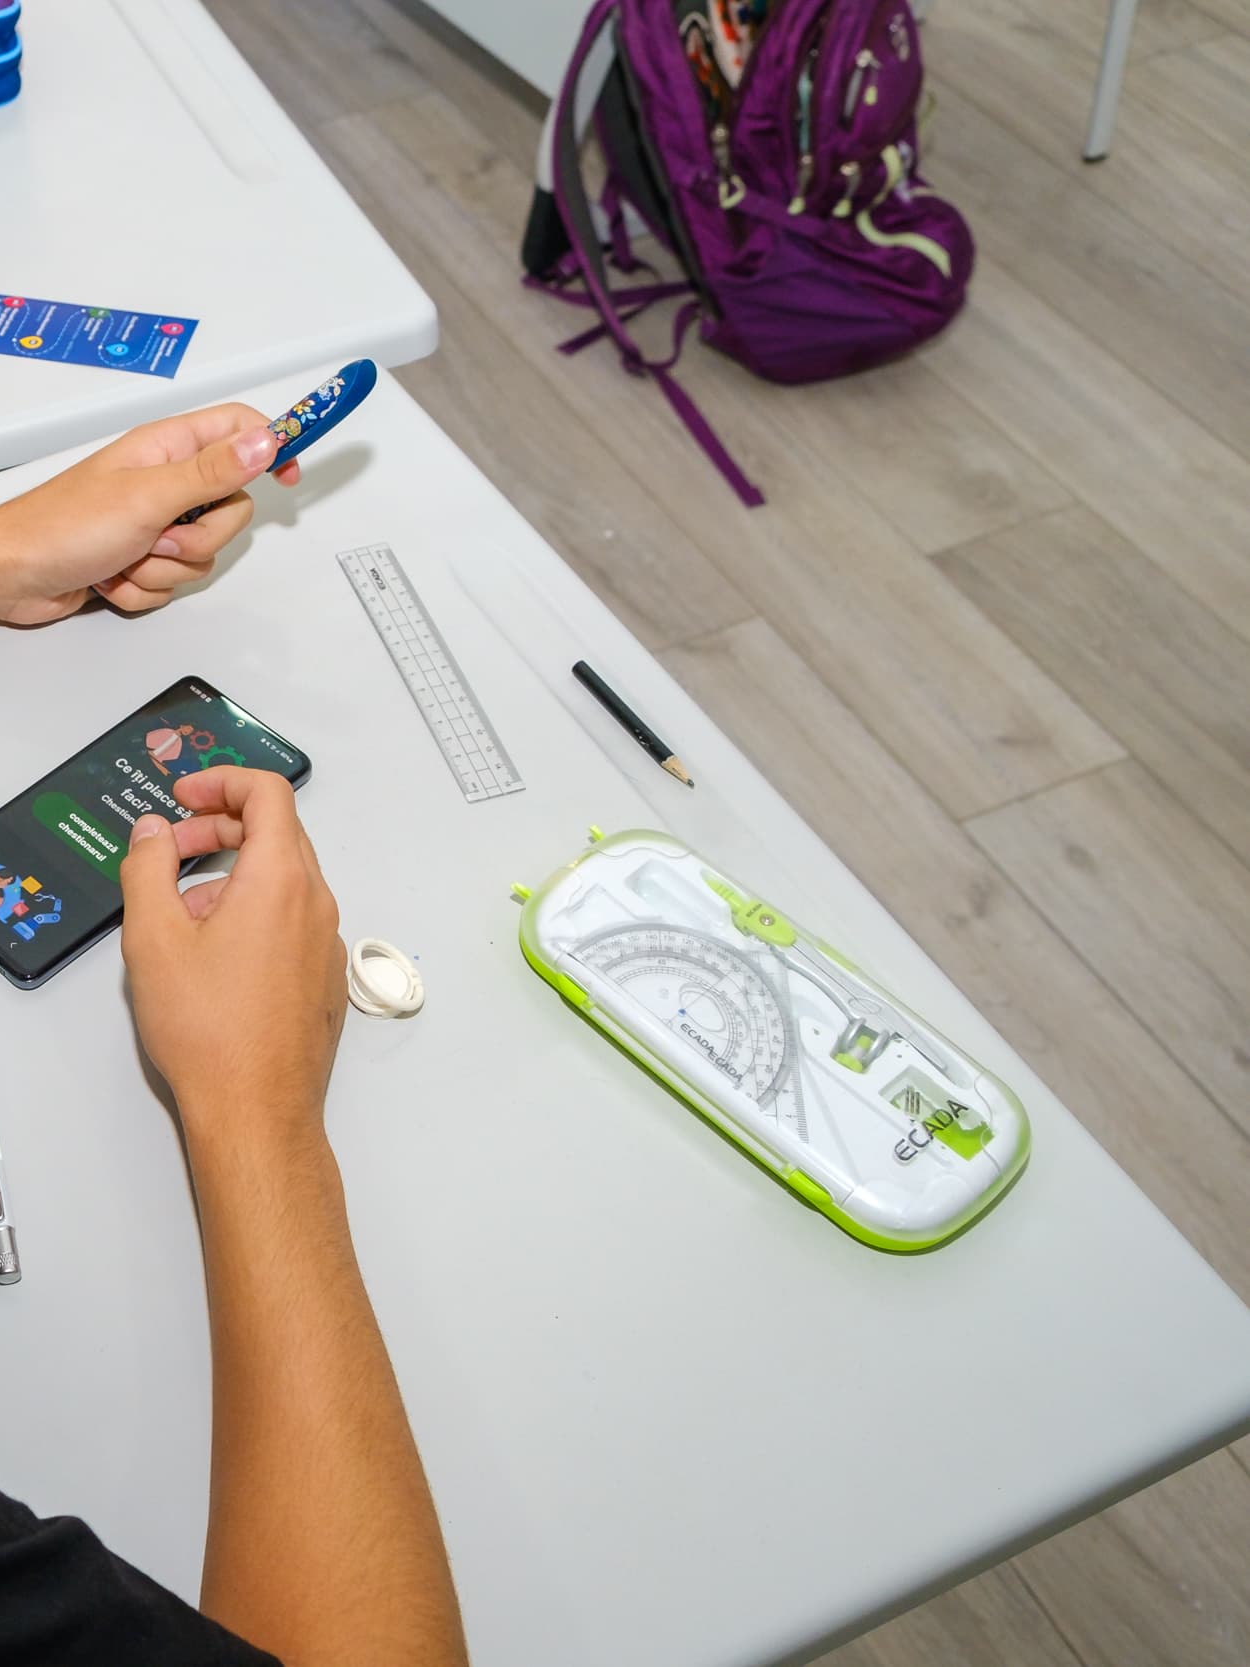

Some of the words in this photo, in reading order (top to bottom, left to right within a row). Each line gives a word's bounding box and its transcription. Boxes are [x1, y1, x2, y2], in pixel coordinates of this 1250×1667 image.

[115, 758, 133, 774] Ce
[140, 780, 176, 808] place
[120, 788, 152, 813] faci?
[101, 794, 135, 825] Chestion
[58, 822, 107, 862] chestionarul
[69, 812, 119, 853] completează
[680, 1022, 715, 1054] ECADA
[707, 1050, 744, 1083] ECADA
[894, 1099, 969, 1162] ECADA
